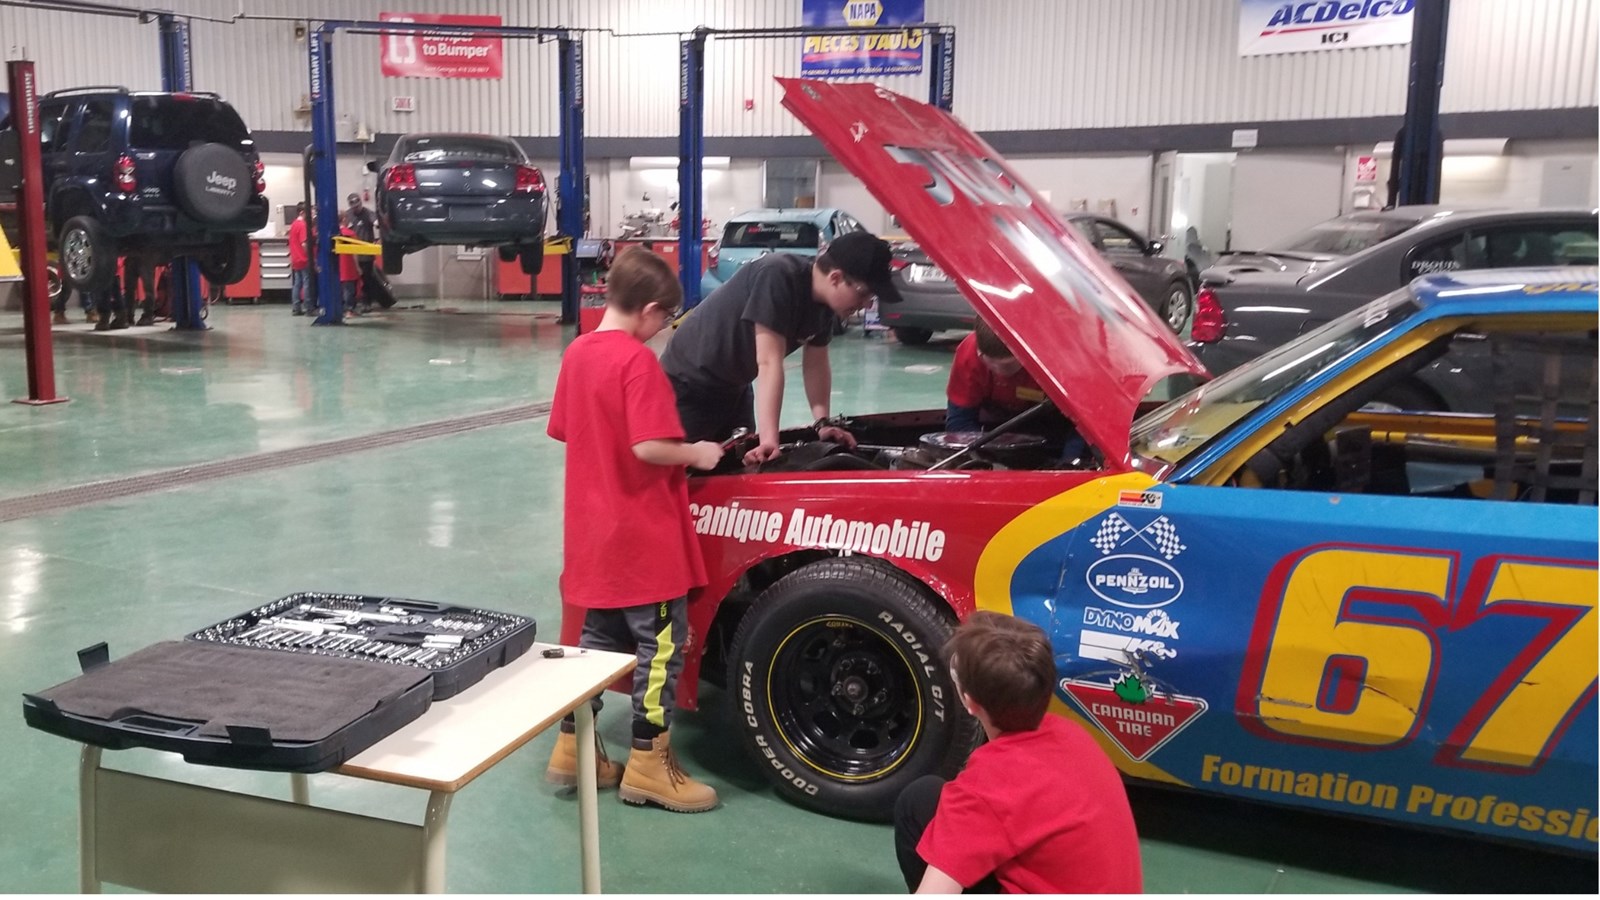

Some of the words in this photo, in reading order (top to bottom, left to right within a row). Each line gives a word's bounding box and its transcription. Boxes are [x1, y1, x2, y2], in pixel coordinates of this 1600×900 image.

[850, 3, 876, 20] NAPA
[1267, 0, 1416, 27] ACDelco
[310, 32, 319, 53] LIFT
[423, 43, 437, 56] to
[438, 43, 489, 60] Bumper
[1321, 32, 1349, 44] ICI
[311, 55, 320, 94] ROTARY
[943, 57, 953, 95] ROTARY
[206, 171, 237, 190] Jeep
[784, 508, 945, 562] Automobile
[1095, 574, 1175, 589] PENNZOIL
[878, 610, 935, 679] RADIAL
[931, 684, 945, 722] G/T
[1236, 541, 1598, 776] 67
[742, 660, 759, 728] COBRA
[1091, 702, 1175, 727] CANADIAN
[1116, 720, 1153, 737] TIRE
[755, 734, 819, 796] COOPER
[1201, 754, 1399, 810] Formation
